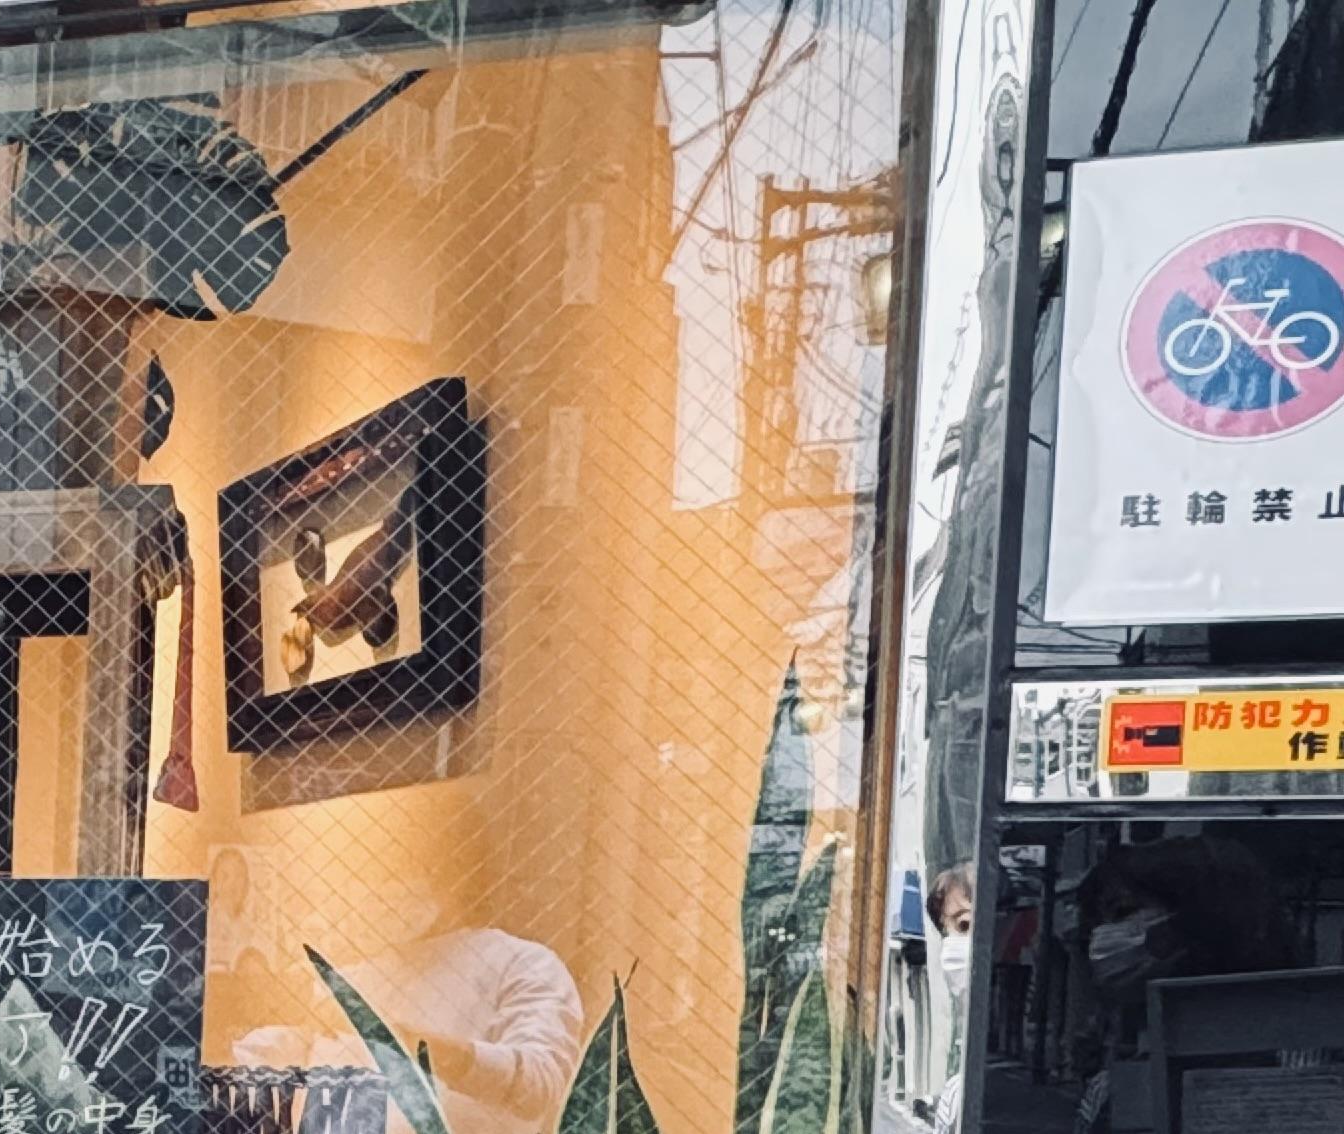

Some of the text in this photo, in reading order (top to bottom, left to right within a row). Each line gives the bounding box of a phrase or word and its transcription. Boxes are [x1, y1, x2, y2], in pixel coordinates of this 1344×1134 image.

[1192, 698, 1344, 731] 防犯カ
[1288, 731, 1344, 761] 作
